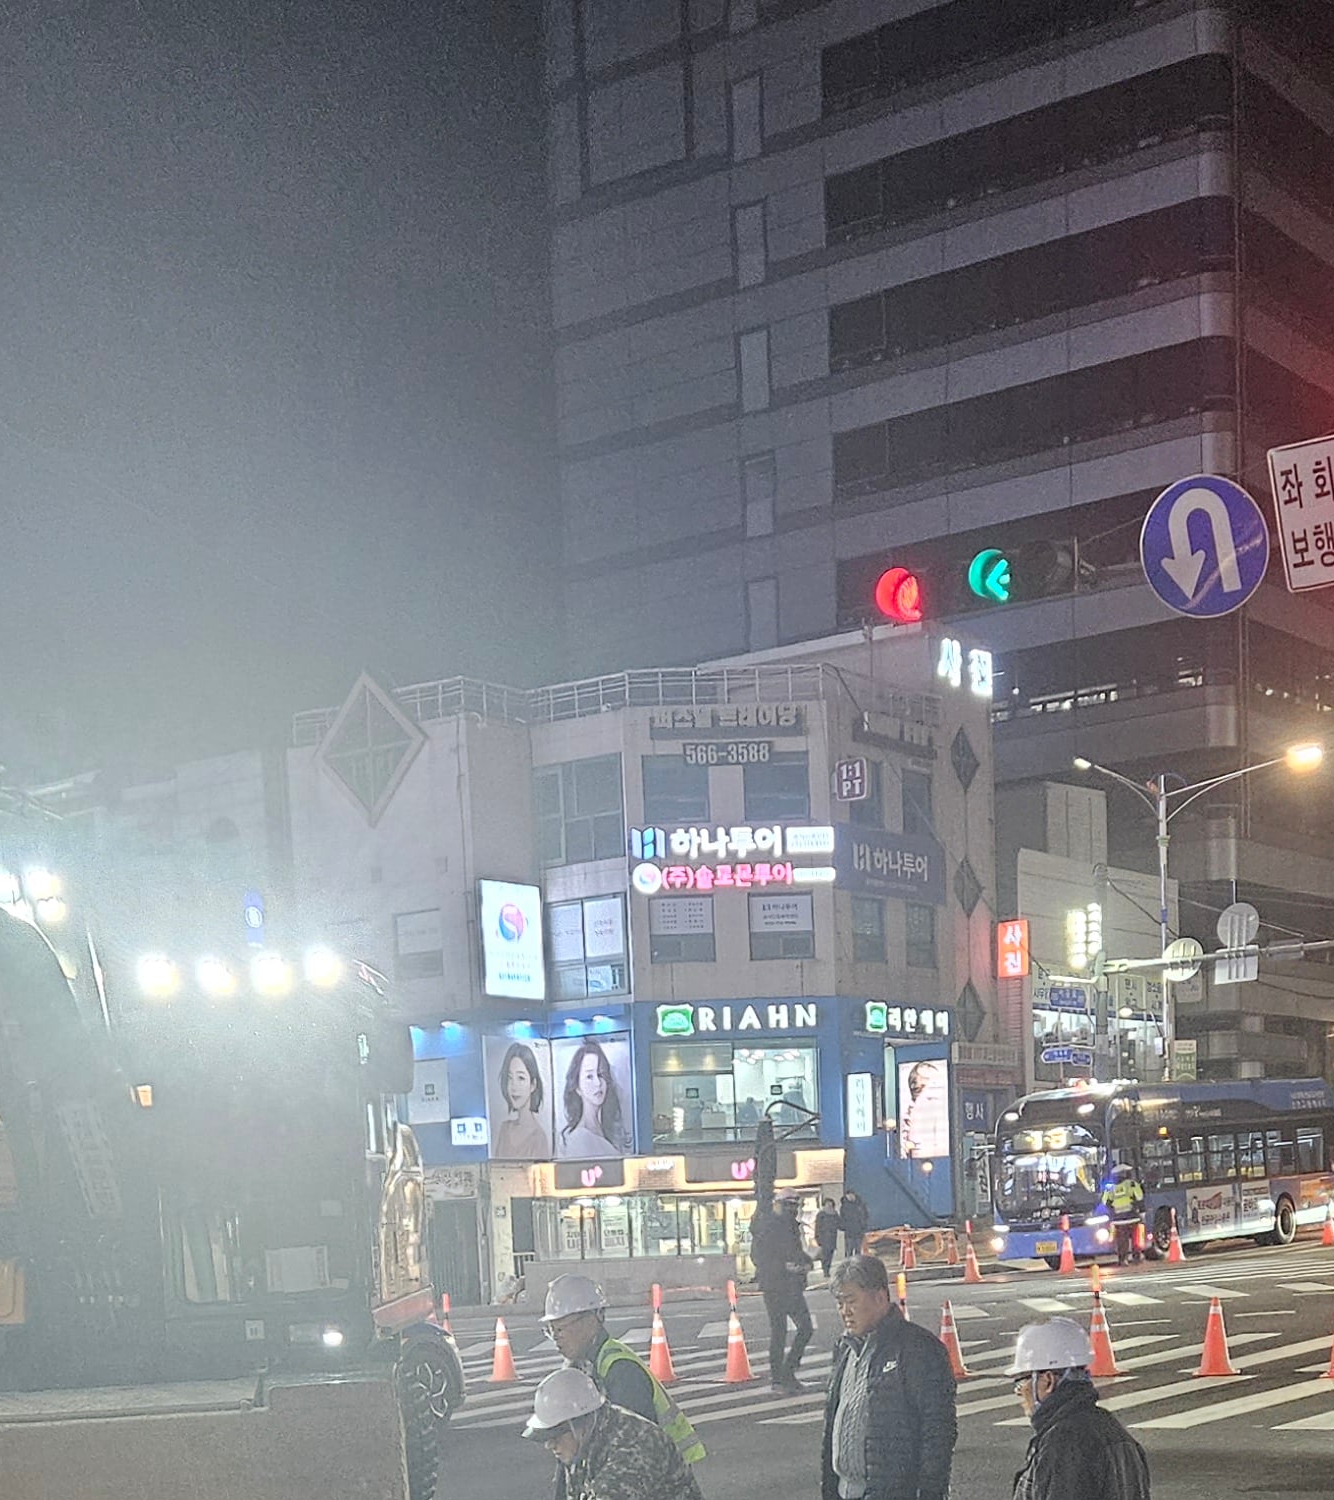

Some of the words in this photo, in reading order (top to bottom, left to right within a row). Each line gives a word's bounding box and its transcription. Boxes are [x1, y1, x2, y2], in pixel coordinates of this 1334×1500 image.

[685, 743, 770, 765] 566-3588
[840, 761, 862, 778] 1:1
[841, 779, 863, 798] PT
[669, 825, 784, 859] 하나투어
[873, 850, 929, 882] 하나투어
[698, 1002, 817, 1031] RIAHN
